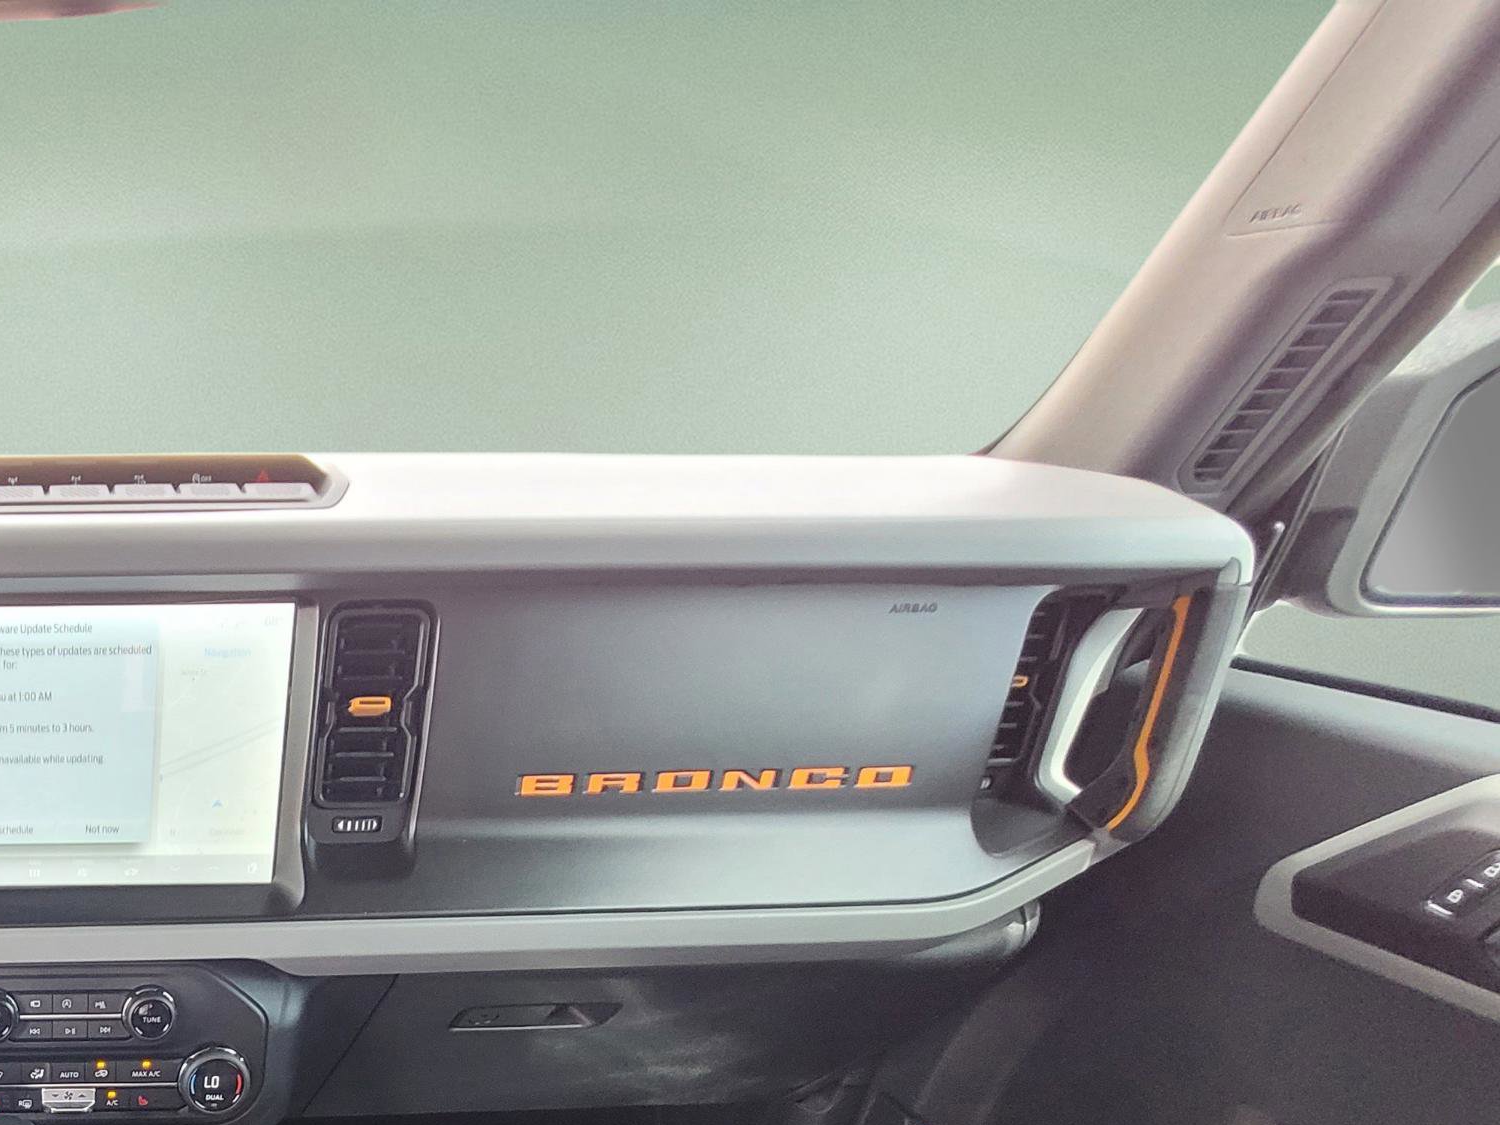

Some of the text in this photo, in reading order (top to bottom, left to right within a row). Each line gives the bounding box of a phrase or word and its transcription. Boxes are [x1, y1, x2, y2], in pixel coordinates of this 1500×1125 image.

[889, 602, 938, 614] AIRBAG
[20, 624, 52, 635] Update
[54, 623, 93, 633] Schedule
[22, 646, 45, 658] types
[46, 646, 56, 656] of
[57, 646, 92, 658] updates
[94, 647, 108, 656] are
[109, 645, 153, 656] scheduled
[7, 692, 17, 702] at
[18, 692, 36, 702] 1:00
[38, 692, 52, 701] AM
[16, 723, 50, 733] minutes
[51, 723, 61, 733] to
[42, 754, 65, 764] while
[516, 765, 914, 796] BRONCO
[85, 824, 120, 834] Not now
[59, 1071, 79, 1079] AUTO
[203, 1075, 220, 1089] LO
